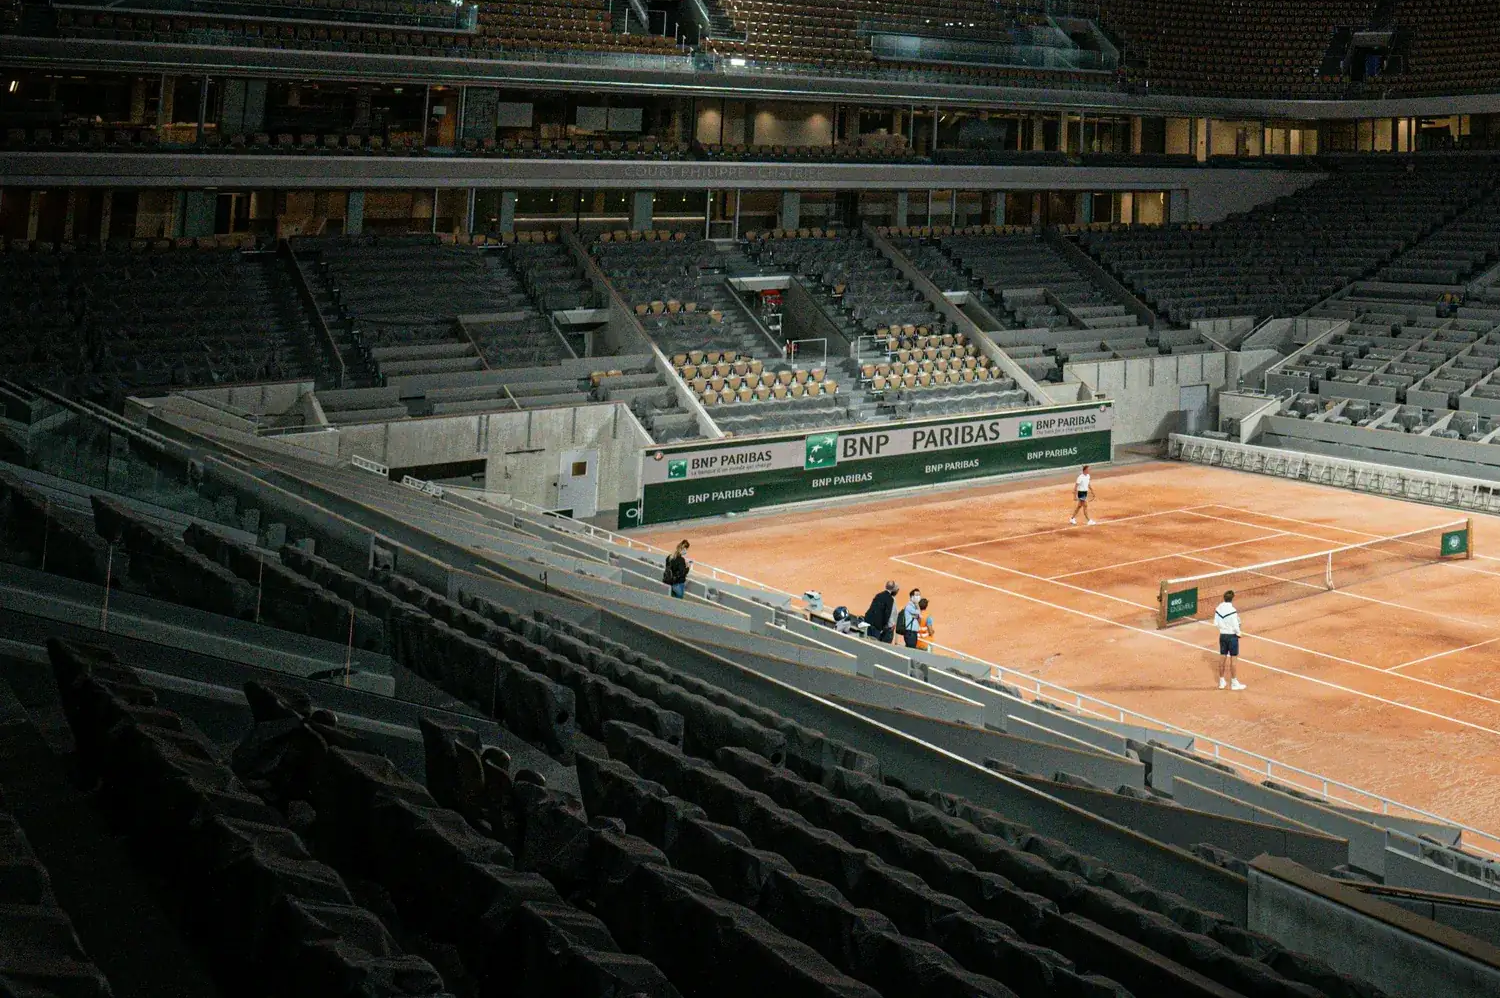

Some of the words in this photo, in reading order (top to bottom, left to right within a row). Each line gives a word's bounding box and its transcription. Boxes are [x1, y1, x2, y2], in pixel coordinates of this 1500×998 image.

[624, 166, 676, 177] COURT
[681, 166, 745, 177] PHILIPPE
[758, 167, 825, 178] CHATRIER
[1036, 419, 1056, 430] BNP
[1058, 414, 1096, 426] PARIBAS
[842, 434, 890, 458] BNP
[912, 422, 1000, 450] PARIBAS
[691, 456, 718, 469] BNP
[721, 450, 772, 466] PARIBAS
[1027, 451, 1044, 460] BNP
[1045, 446, 1078, 458] PARIBAS
[925, 464, 943, 474] BNP
[945, 458, 979, 471] PARIBAS
[812, 477, 832, 488] BNP
[833, 472, 873, 485] PARIBAS
[688, 493, 710, 504] BNP
[712, 487, 755, 501] PARIBAS
